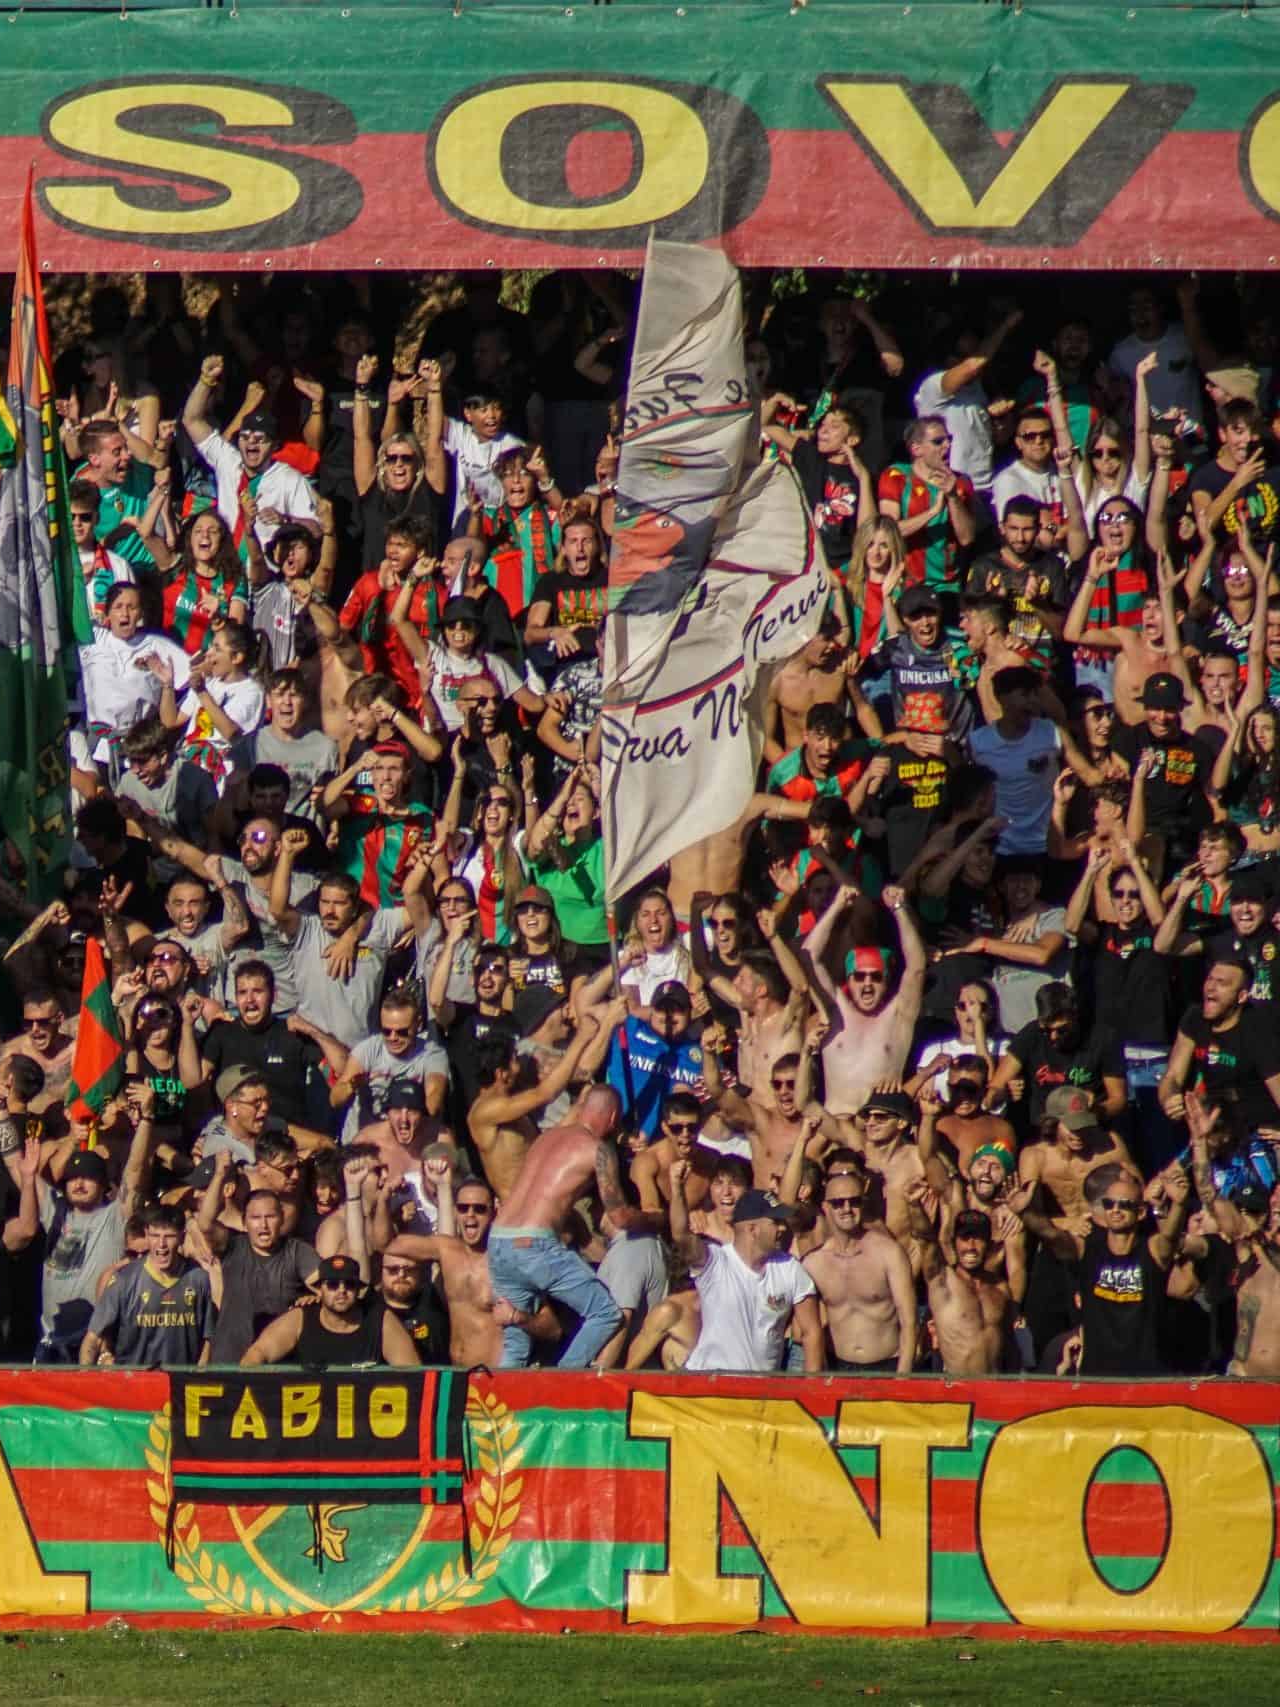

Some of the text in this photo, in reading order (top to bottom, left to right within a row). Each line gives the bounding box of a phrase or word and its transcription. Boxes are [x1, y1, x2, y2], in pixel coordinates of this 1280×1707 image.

[900, 670, 951, 685] UNICUSA
[184, 1384, 409, 1439] FABIO
[626, 1390, 1276, 1632] NO
